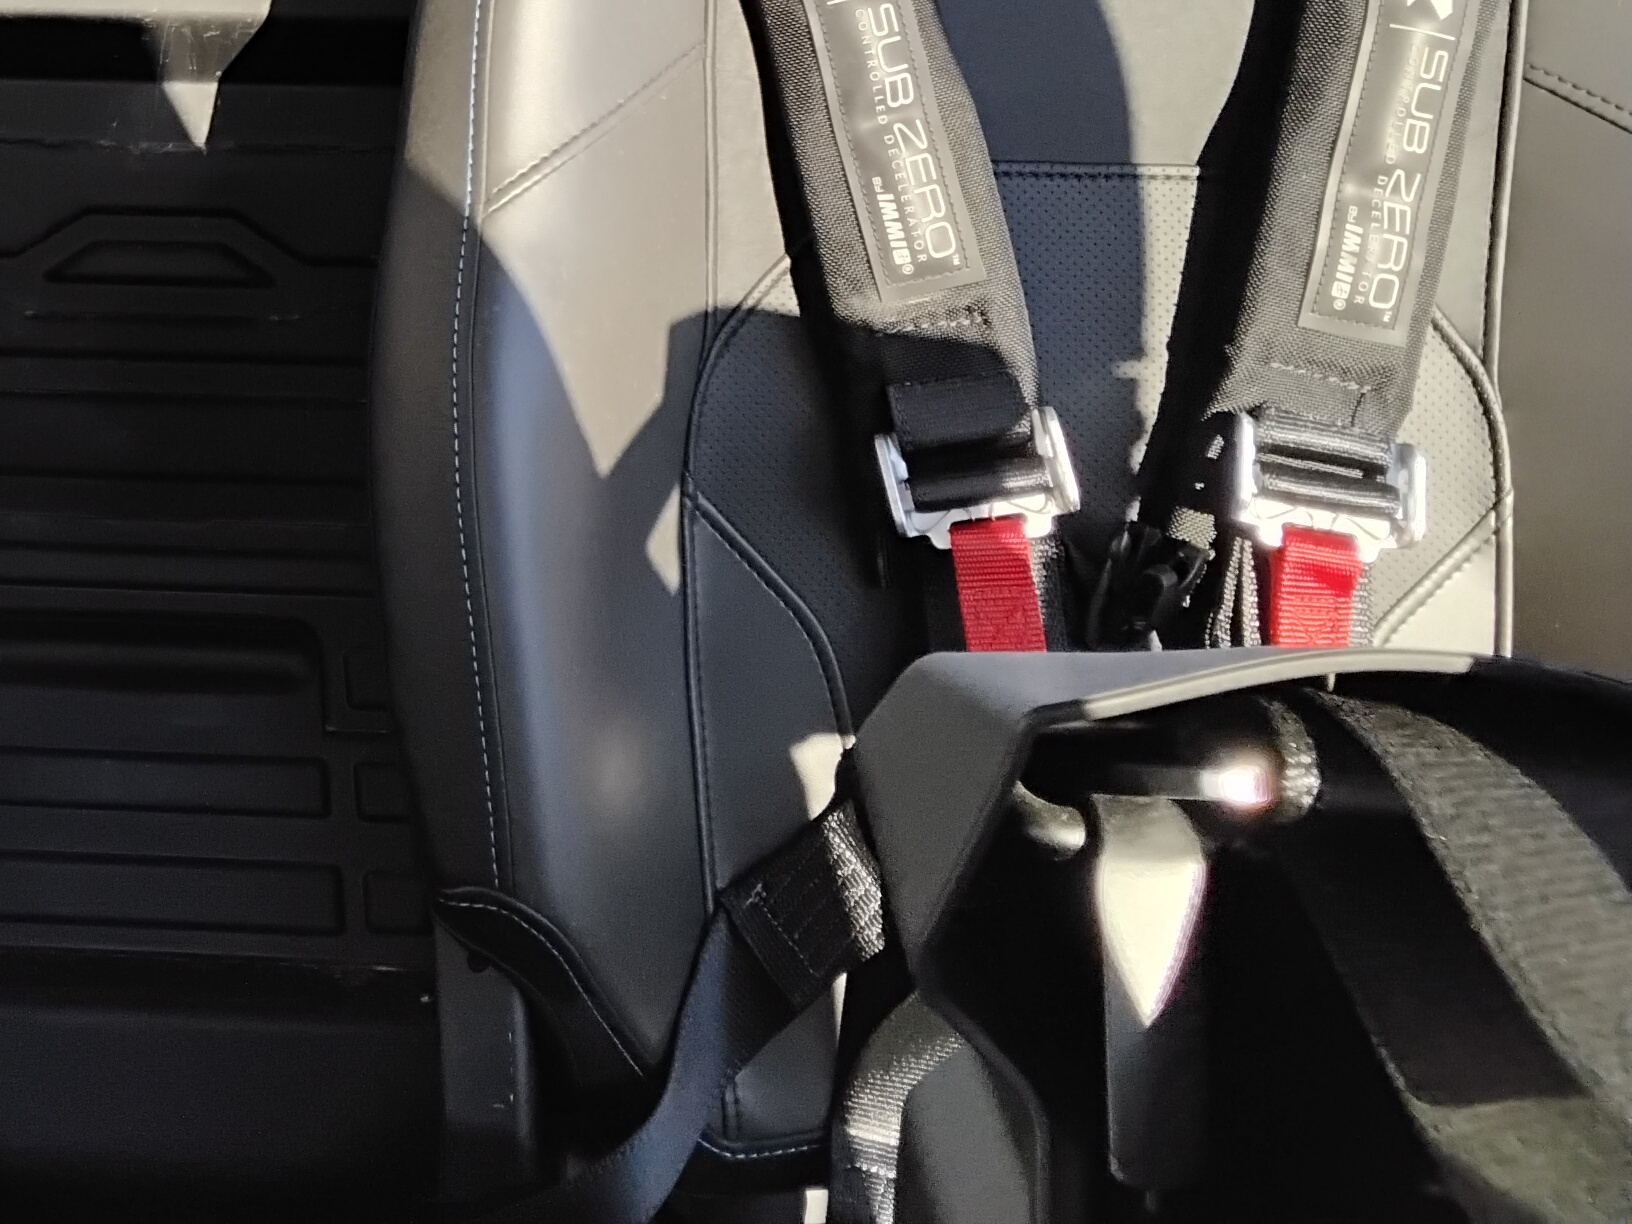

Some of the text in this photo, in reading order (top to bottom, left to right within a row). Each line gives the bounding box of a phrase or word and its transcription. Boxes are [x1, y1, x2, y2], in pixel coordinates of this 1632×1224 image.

[855, 9, 927, 263] CONTROLLED DECELERATOR
[868, 3, 914, 108] SUB
[893, 119, 956, 258] ZERO
[1402, 47, 1449, 154] SUB
[1369, 168, 1421, 309] ZERO
